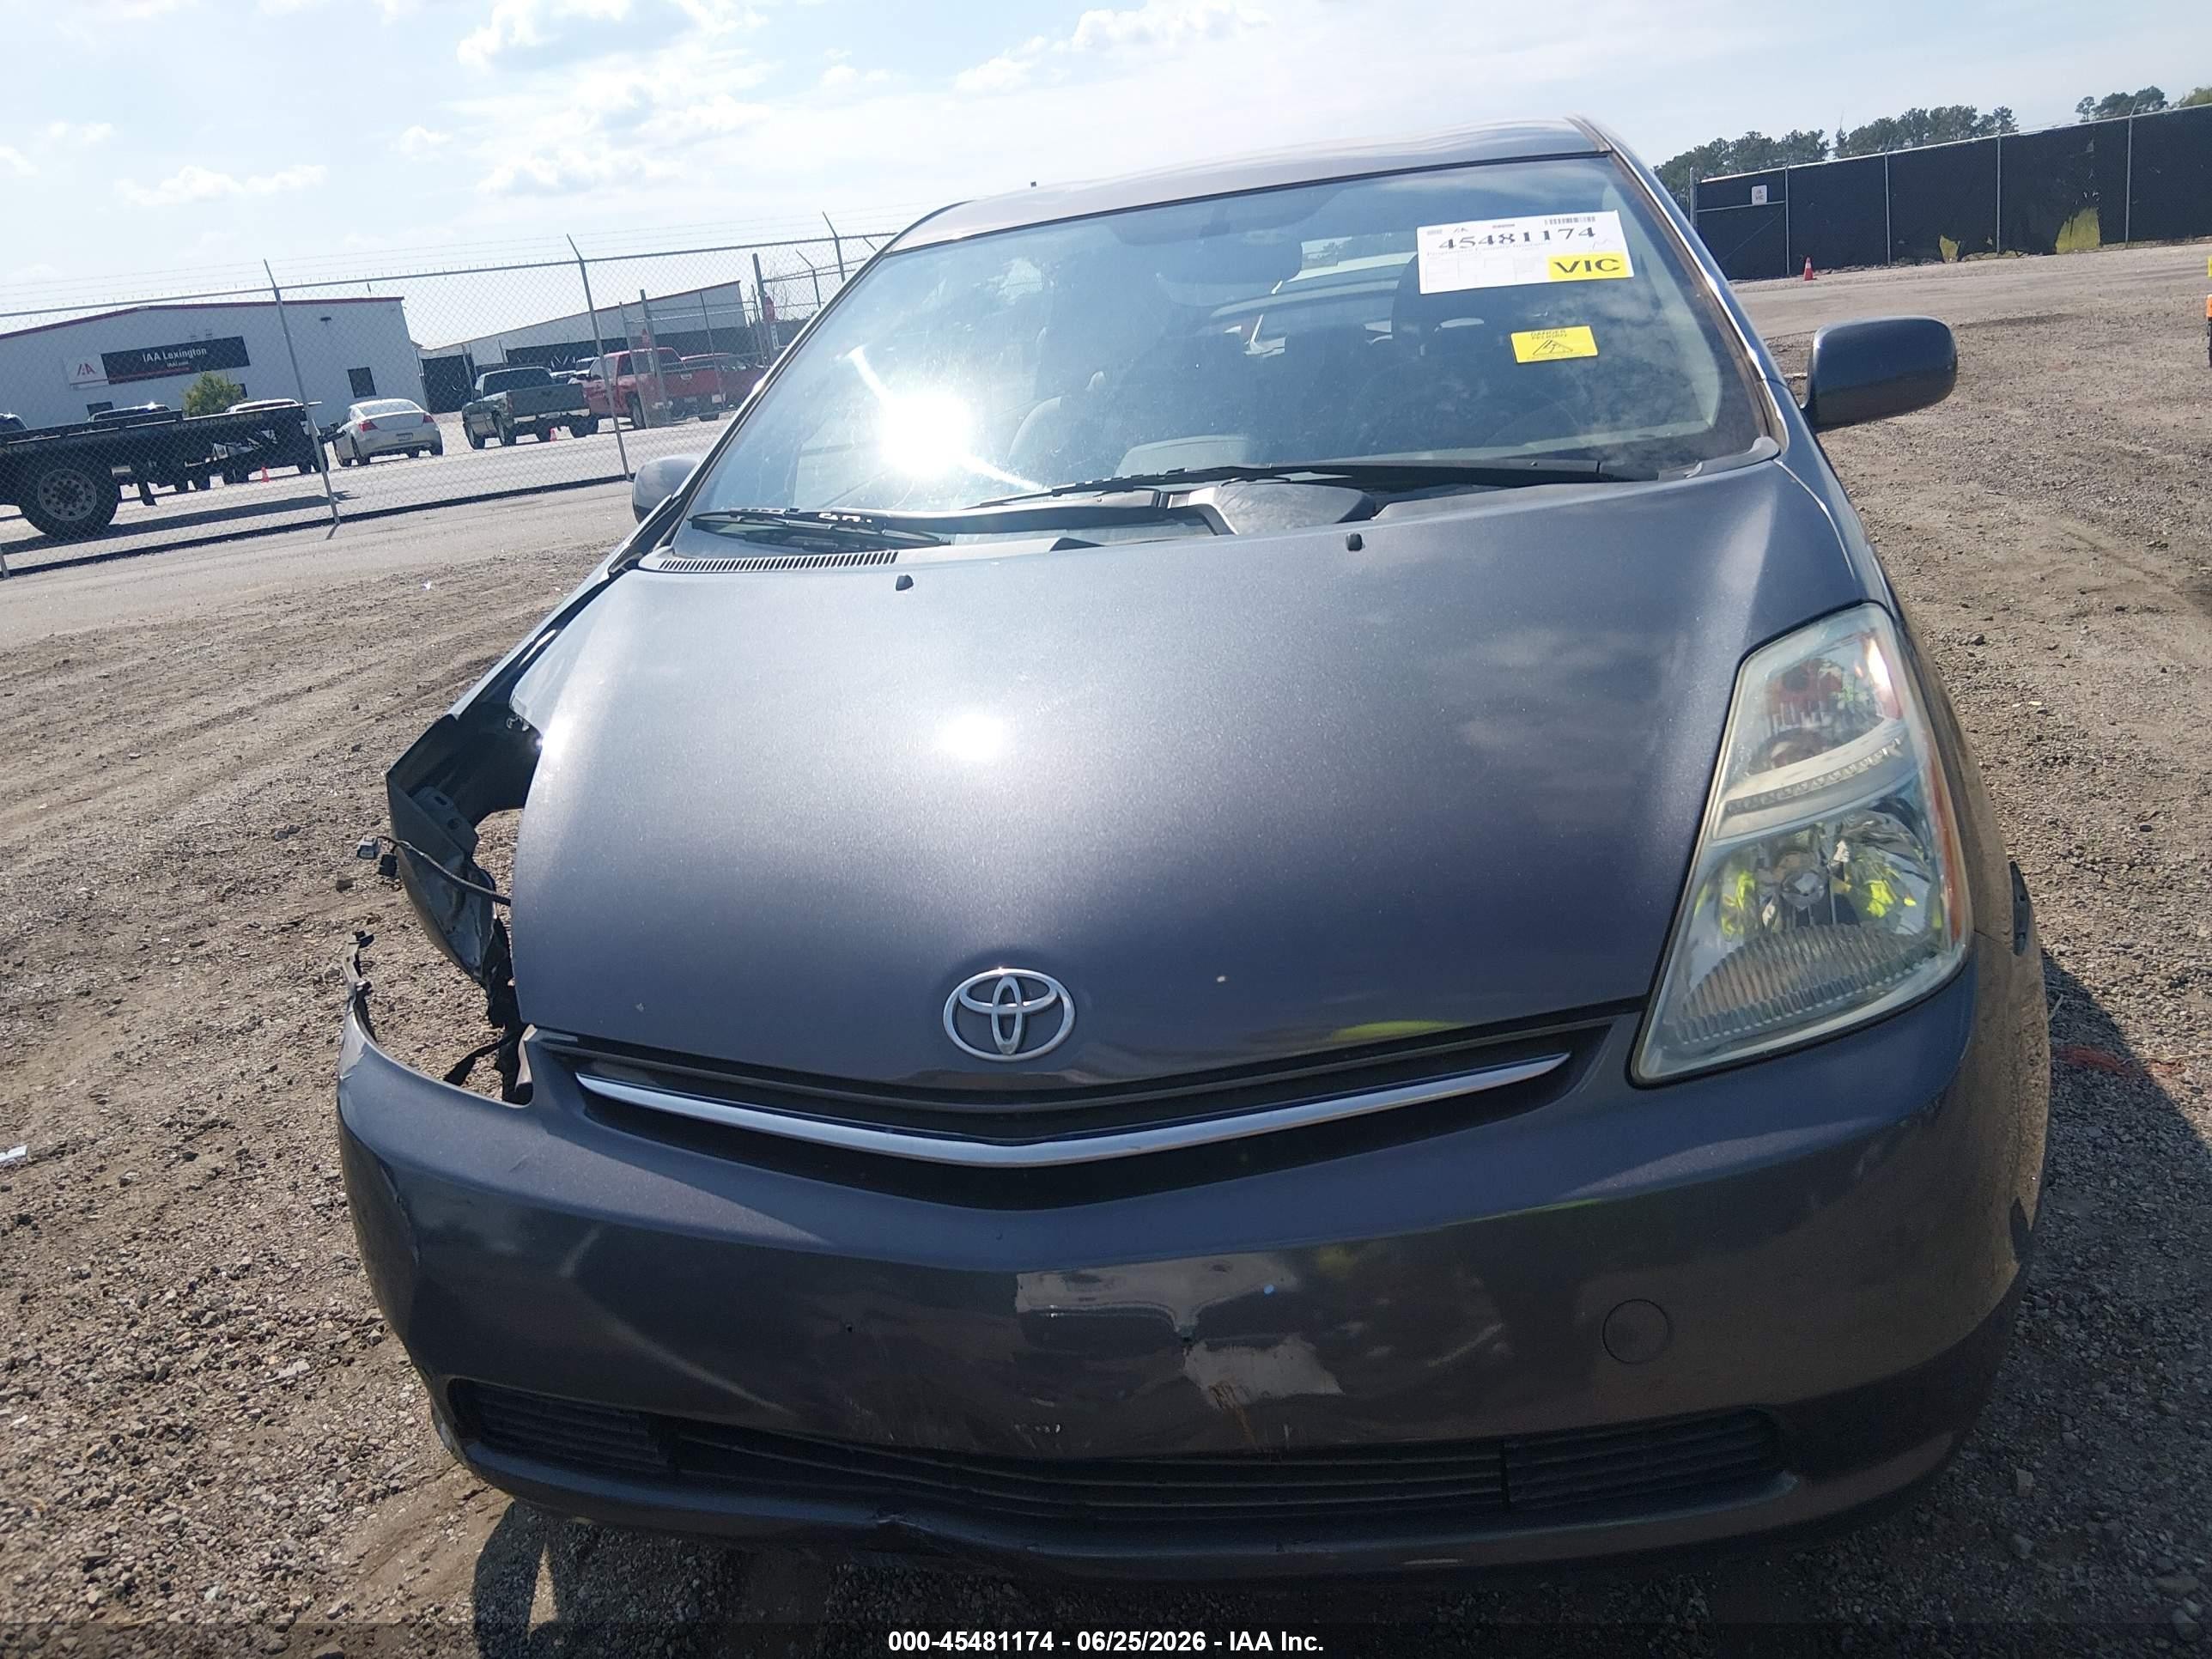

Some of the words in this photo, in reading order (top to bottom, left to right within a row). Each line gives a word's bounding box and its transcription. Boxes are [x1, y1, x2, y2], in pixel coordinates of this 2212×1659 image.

[1438, 226, 1596, 250] 45481174
[1554, 258, 1620, 274] VIC
[143, 351, 161, 362] IAA
[162, 348, 207, 360] Lexington
